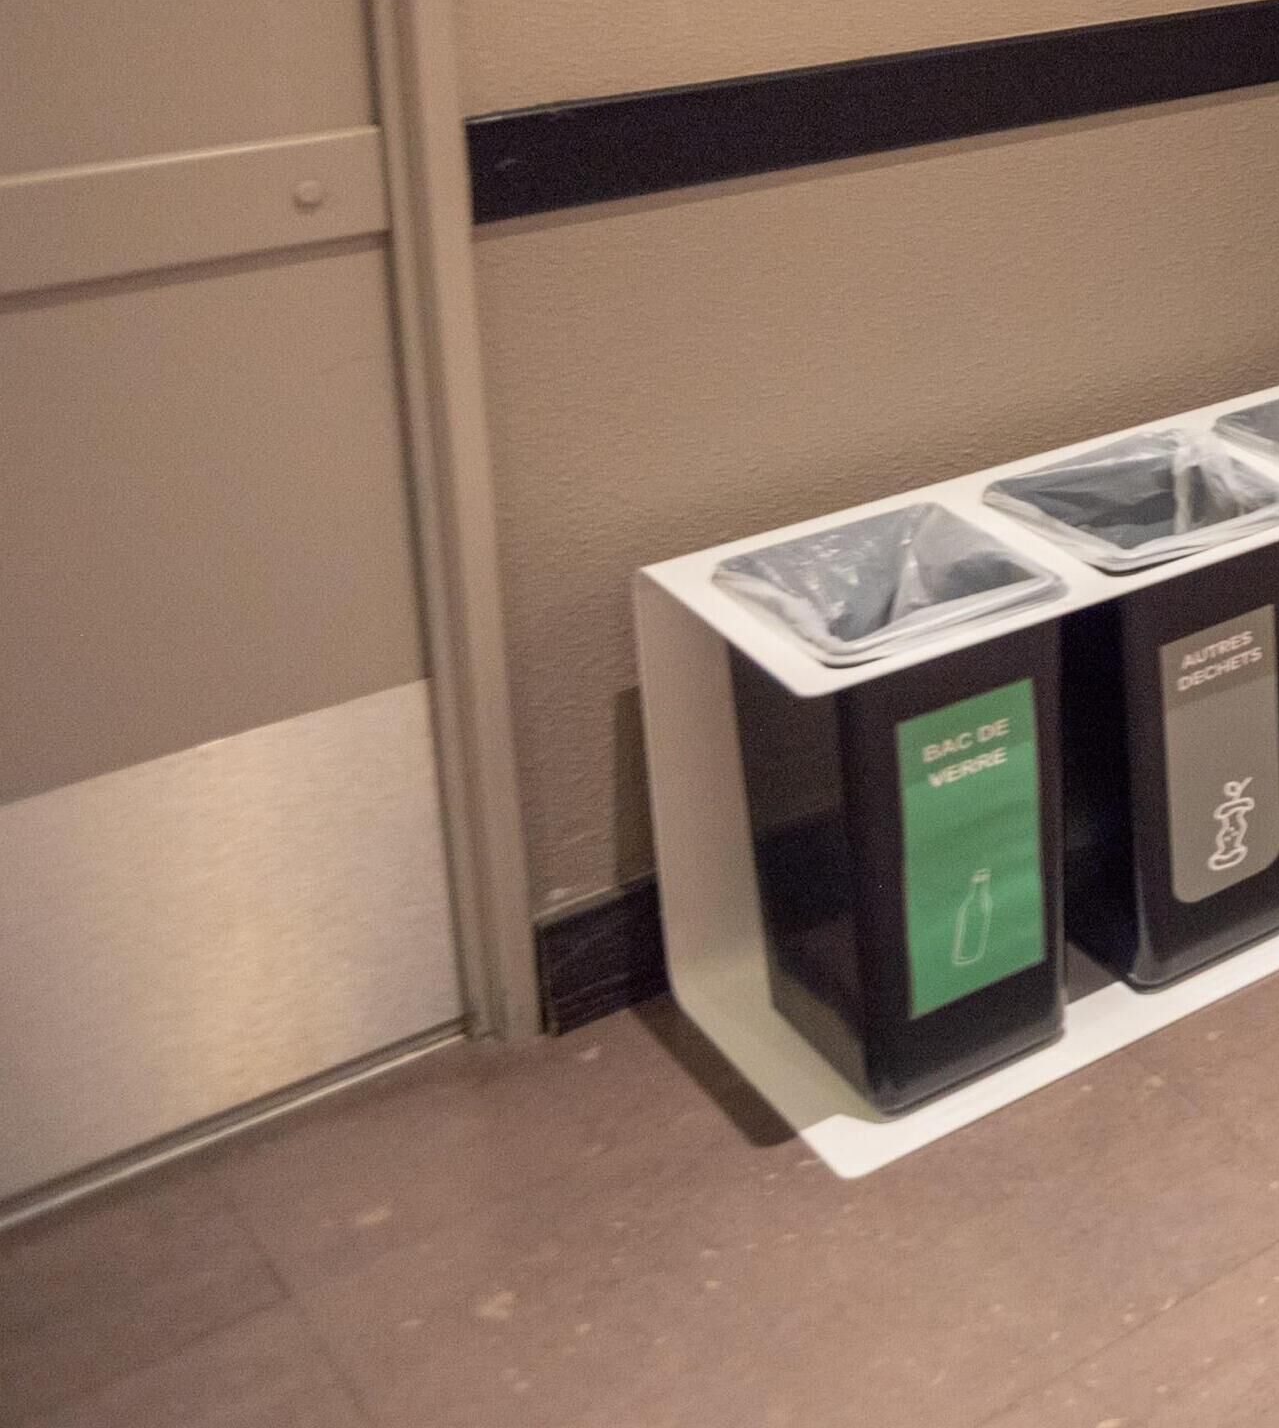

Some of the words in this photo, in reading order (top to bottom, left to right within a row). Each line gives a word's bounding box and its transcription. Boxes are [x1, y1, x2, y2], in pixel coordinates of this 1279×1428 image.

[1177, 646, 1264, 691] DECHETS
[1181, 630, 1253, 670] AUTRES
[922, 731, 974, 764] BAC
[975, 717, 1011, 743] DE
[927, 746, 1009, 787] VERRE
